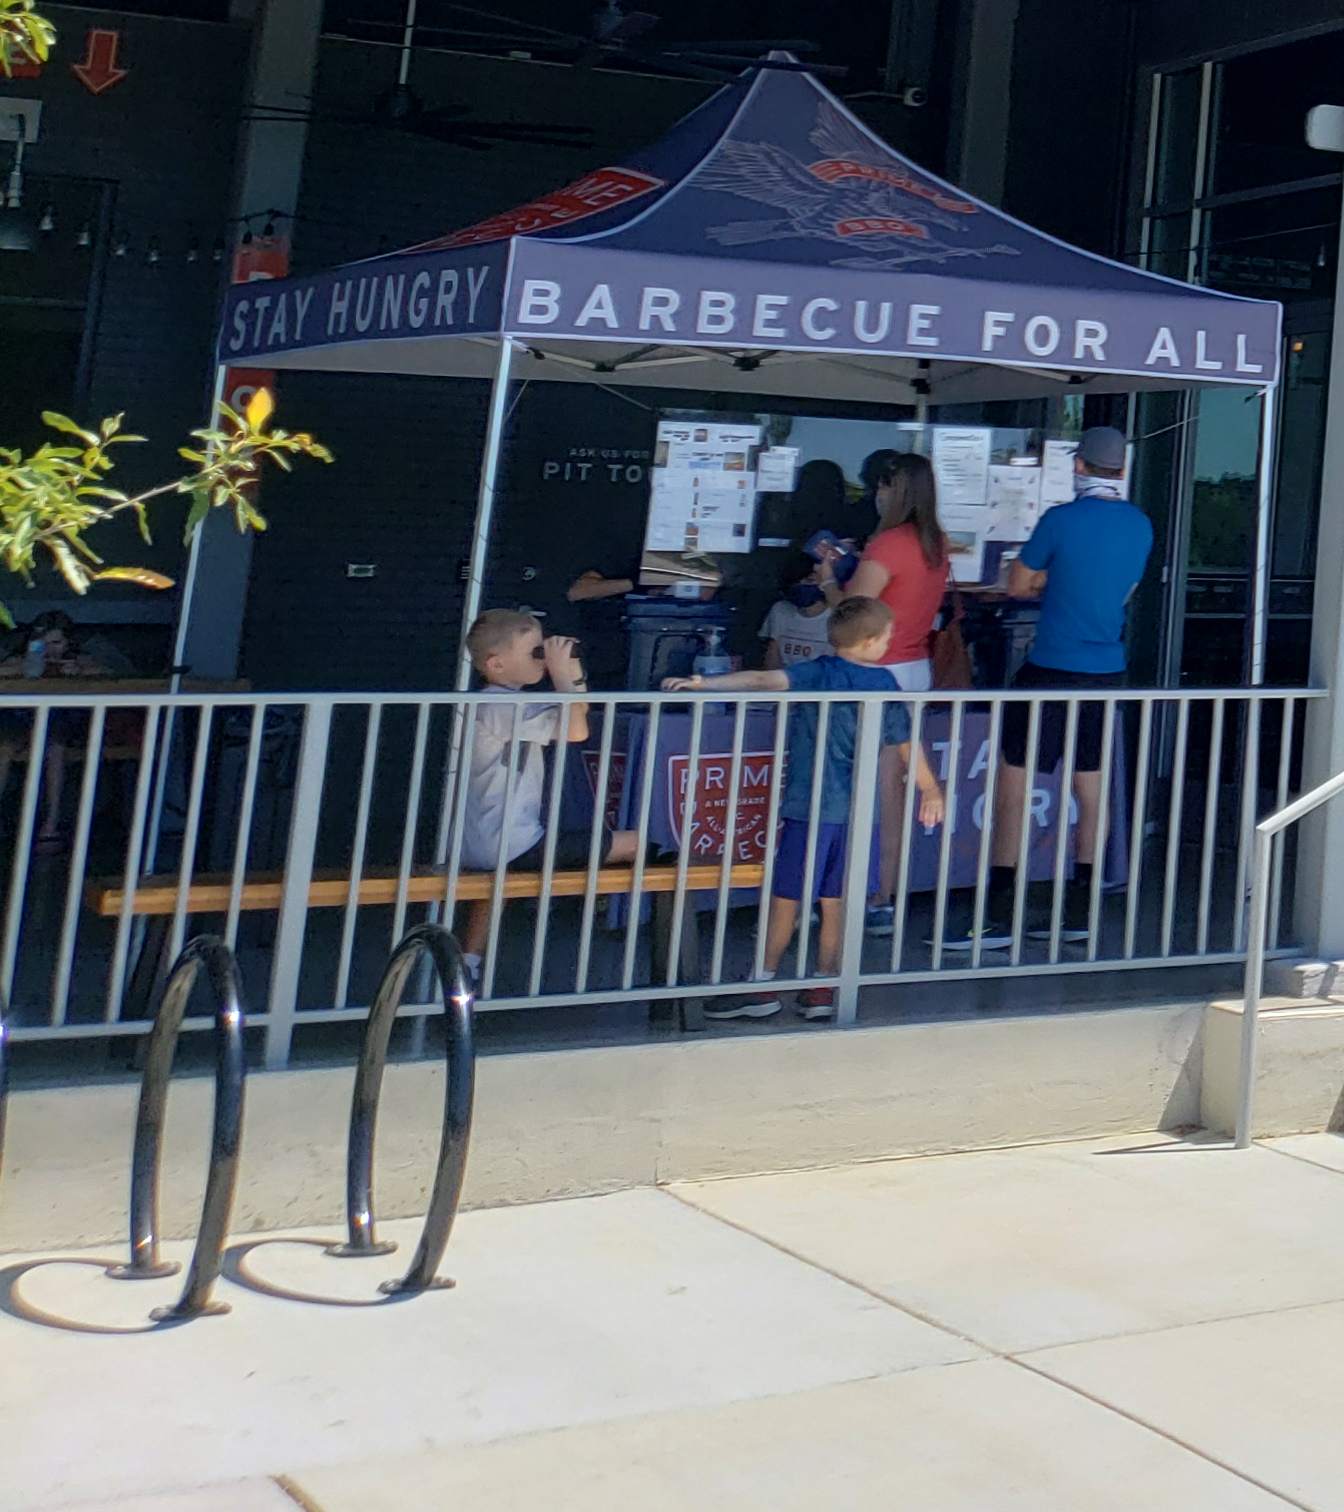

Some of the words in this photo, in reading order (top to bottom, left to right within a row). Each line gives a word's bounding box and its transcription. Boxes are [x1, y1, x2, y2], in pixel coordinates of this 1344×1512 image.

[228, 287, 314, 352] STAY
[326, 265, 490, 336] HUNGRY
[517, 279, 942, 347] BARBECUE
[981, 310, 1109, 361] FOR
[1144, 326, 1263, 374] ALL
[543, 461, 593, 482] PIT
